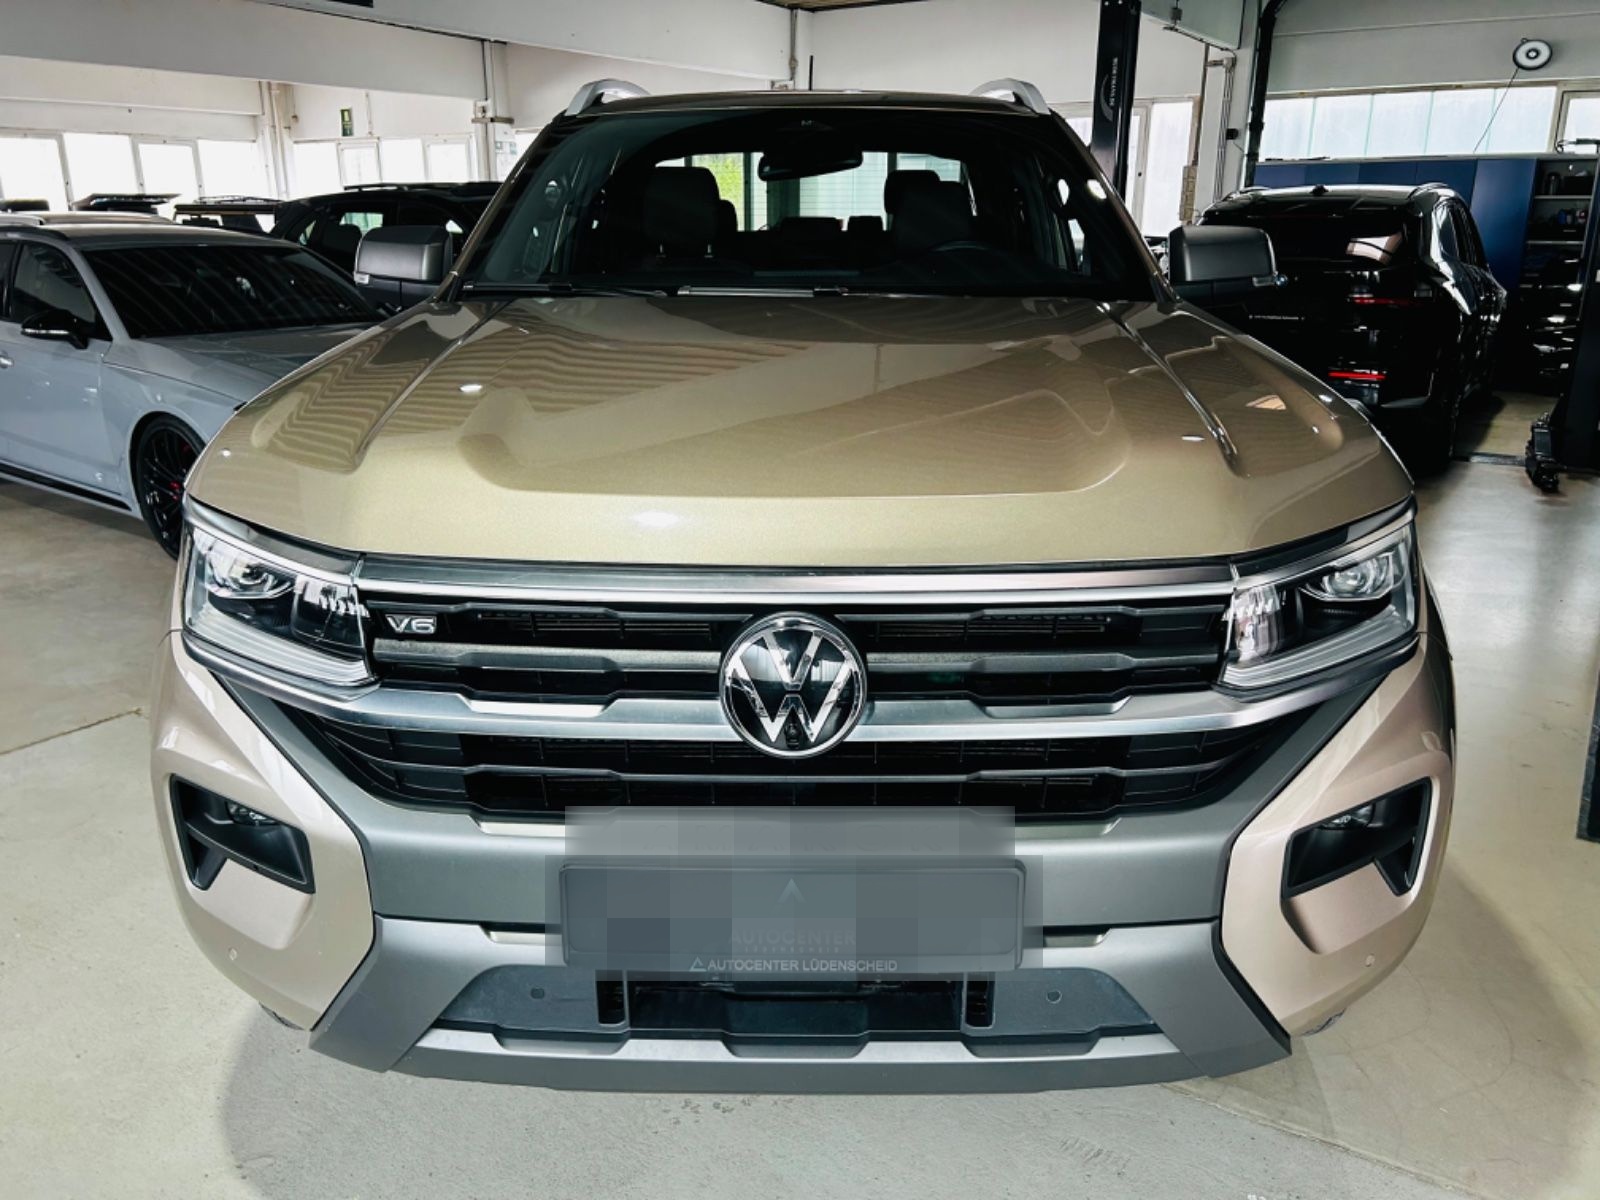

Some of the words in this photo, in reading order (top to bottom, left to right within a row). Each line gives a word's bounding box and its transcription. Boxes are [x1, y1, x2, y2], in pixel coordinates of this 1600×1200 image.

[386, 614, 437, 634] V6
[729, 929, 856, 945] AUTOCENTER
[707, 959, 799, 971] AUTOCENTER
[802, 958, 898, 971] LÜDENSCHEID
